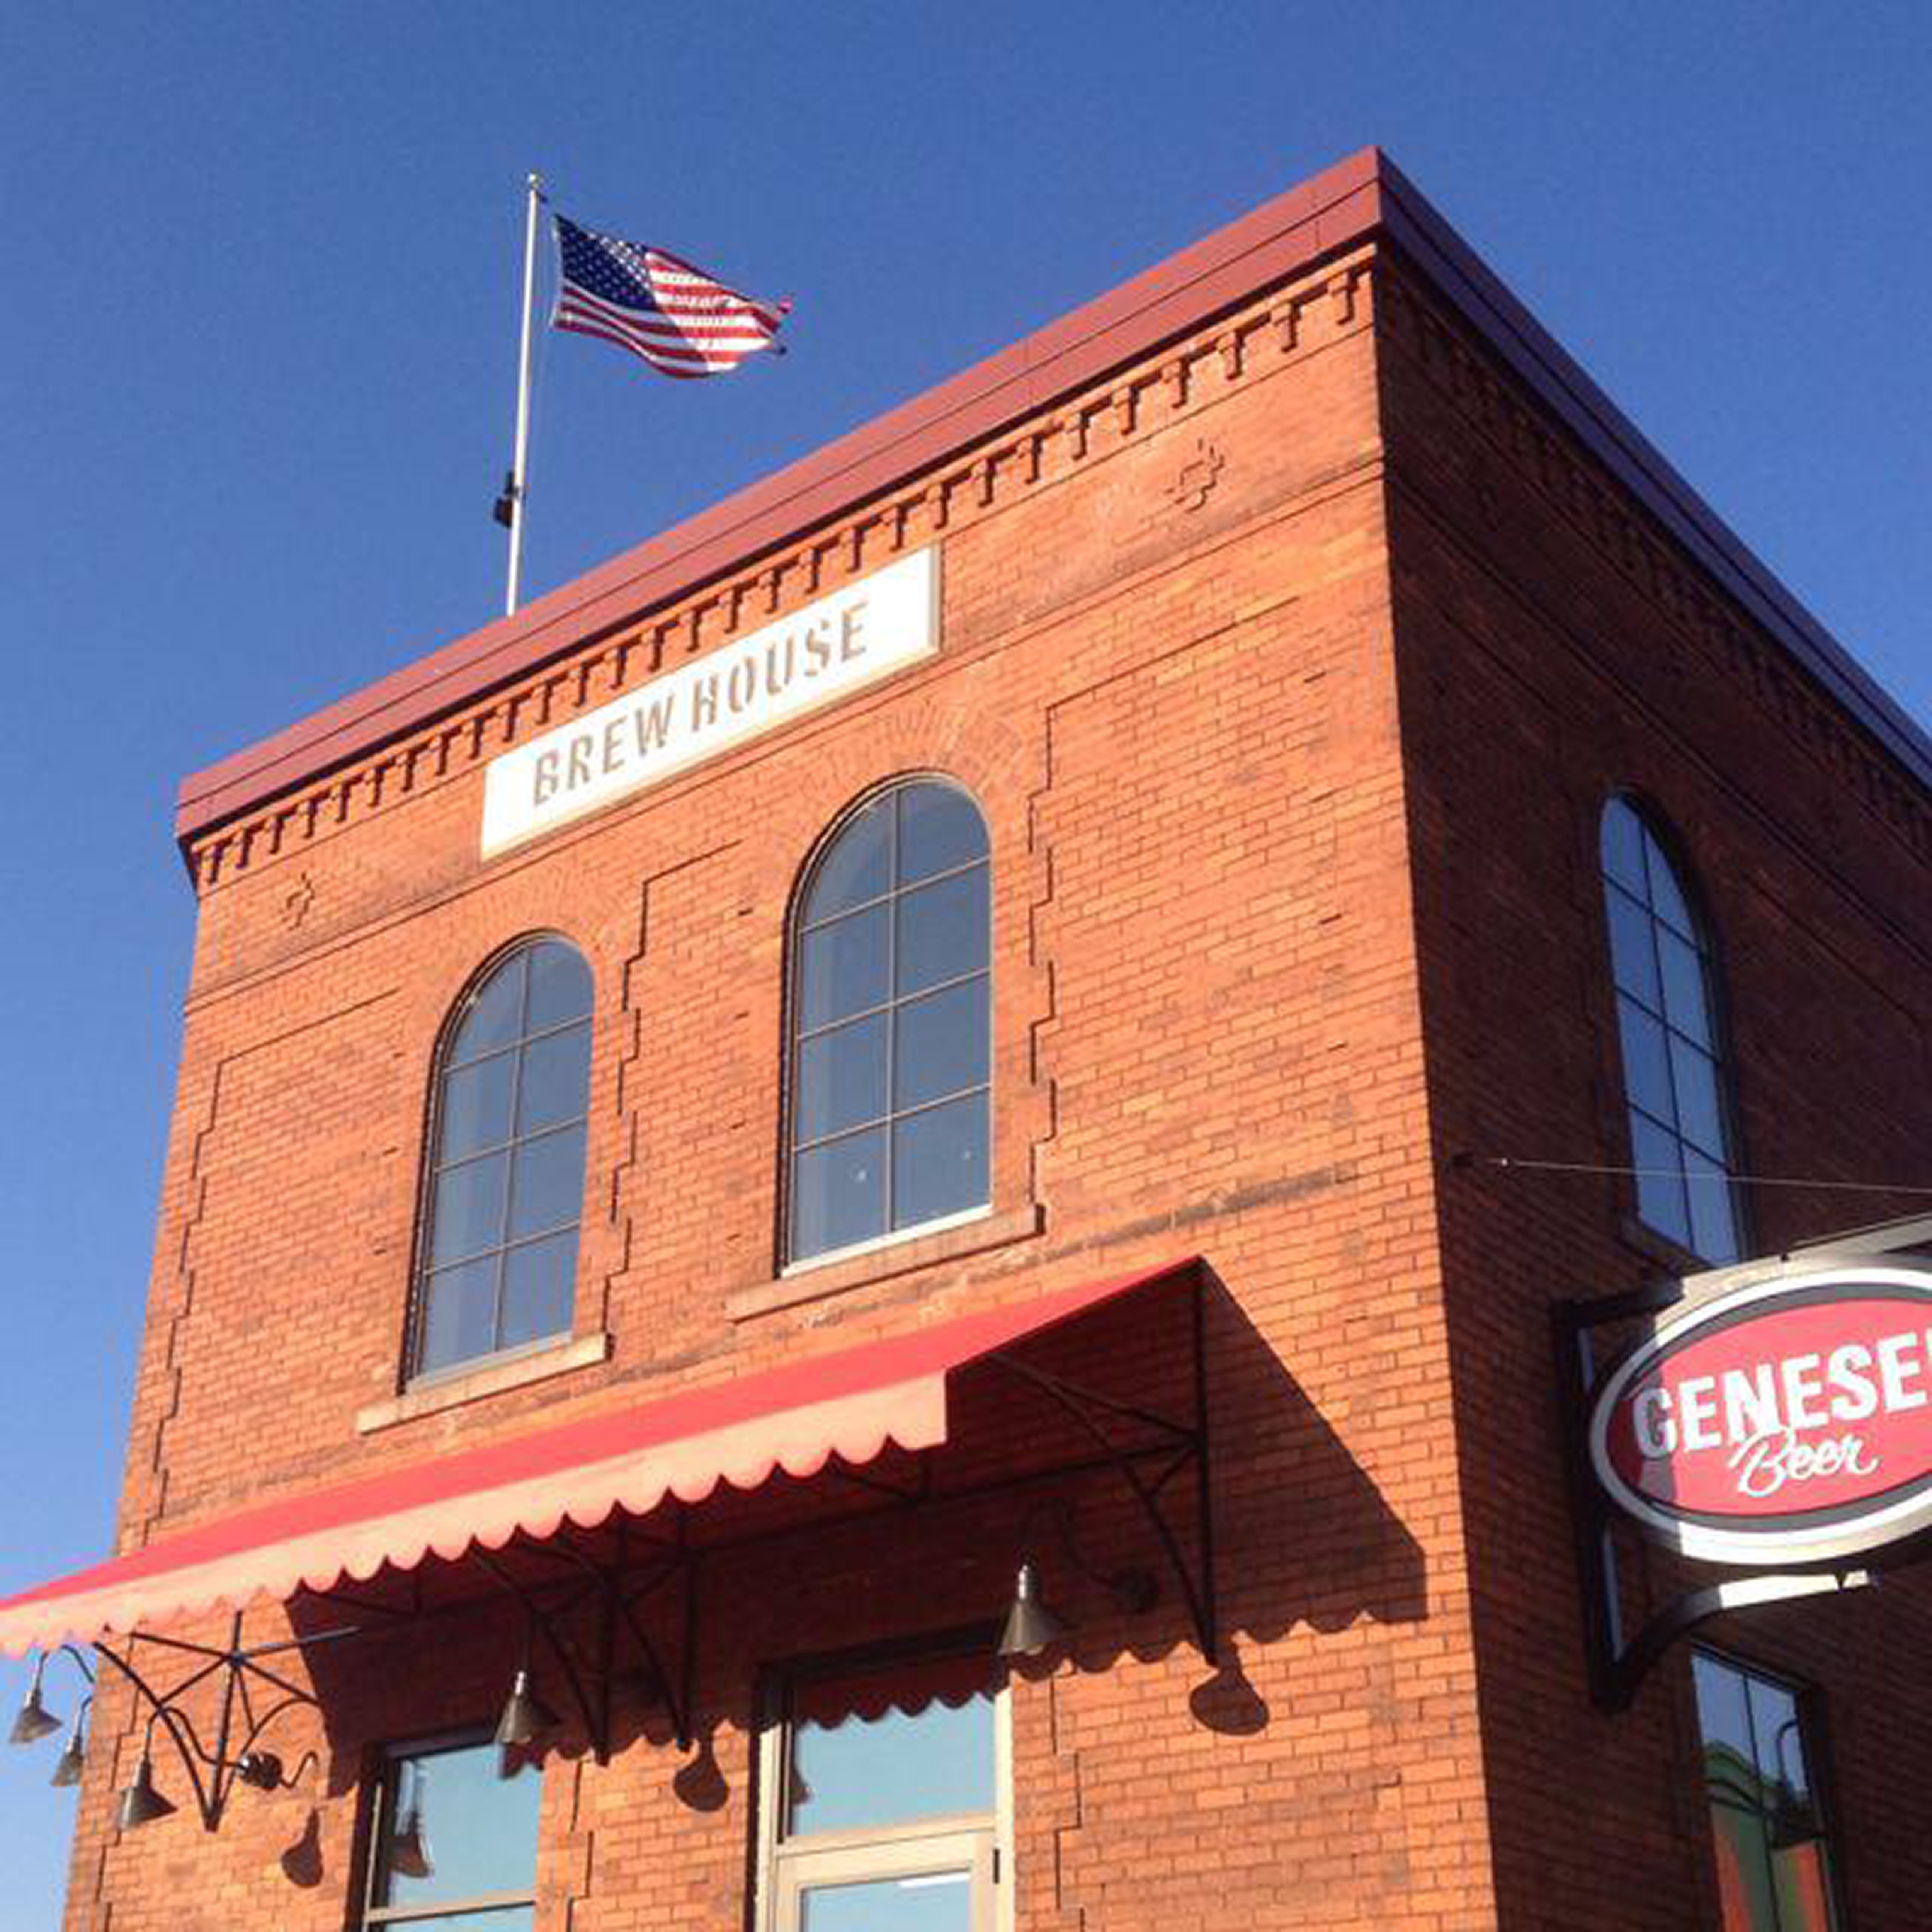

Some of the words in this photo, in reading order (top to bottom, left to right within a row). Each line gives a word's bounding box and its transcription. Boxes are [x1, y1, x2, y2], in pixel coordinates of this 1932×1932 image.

[533, 692, 675, 805] BREW
[692, 599, 869, 733] HOUSE
[1633, 1328, 1932, 1459] GENESE
[1729, 1424, 1879, 1498] Beer
